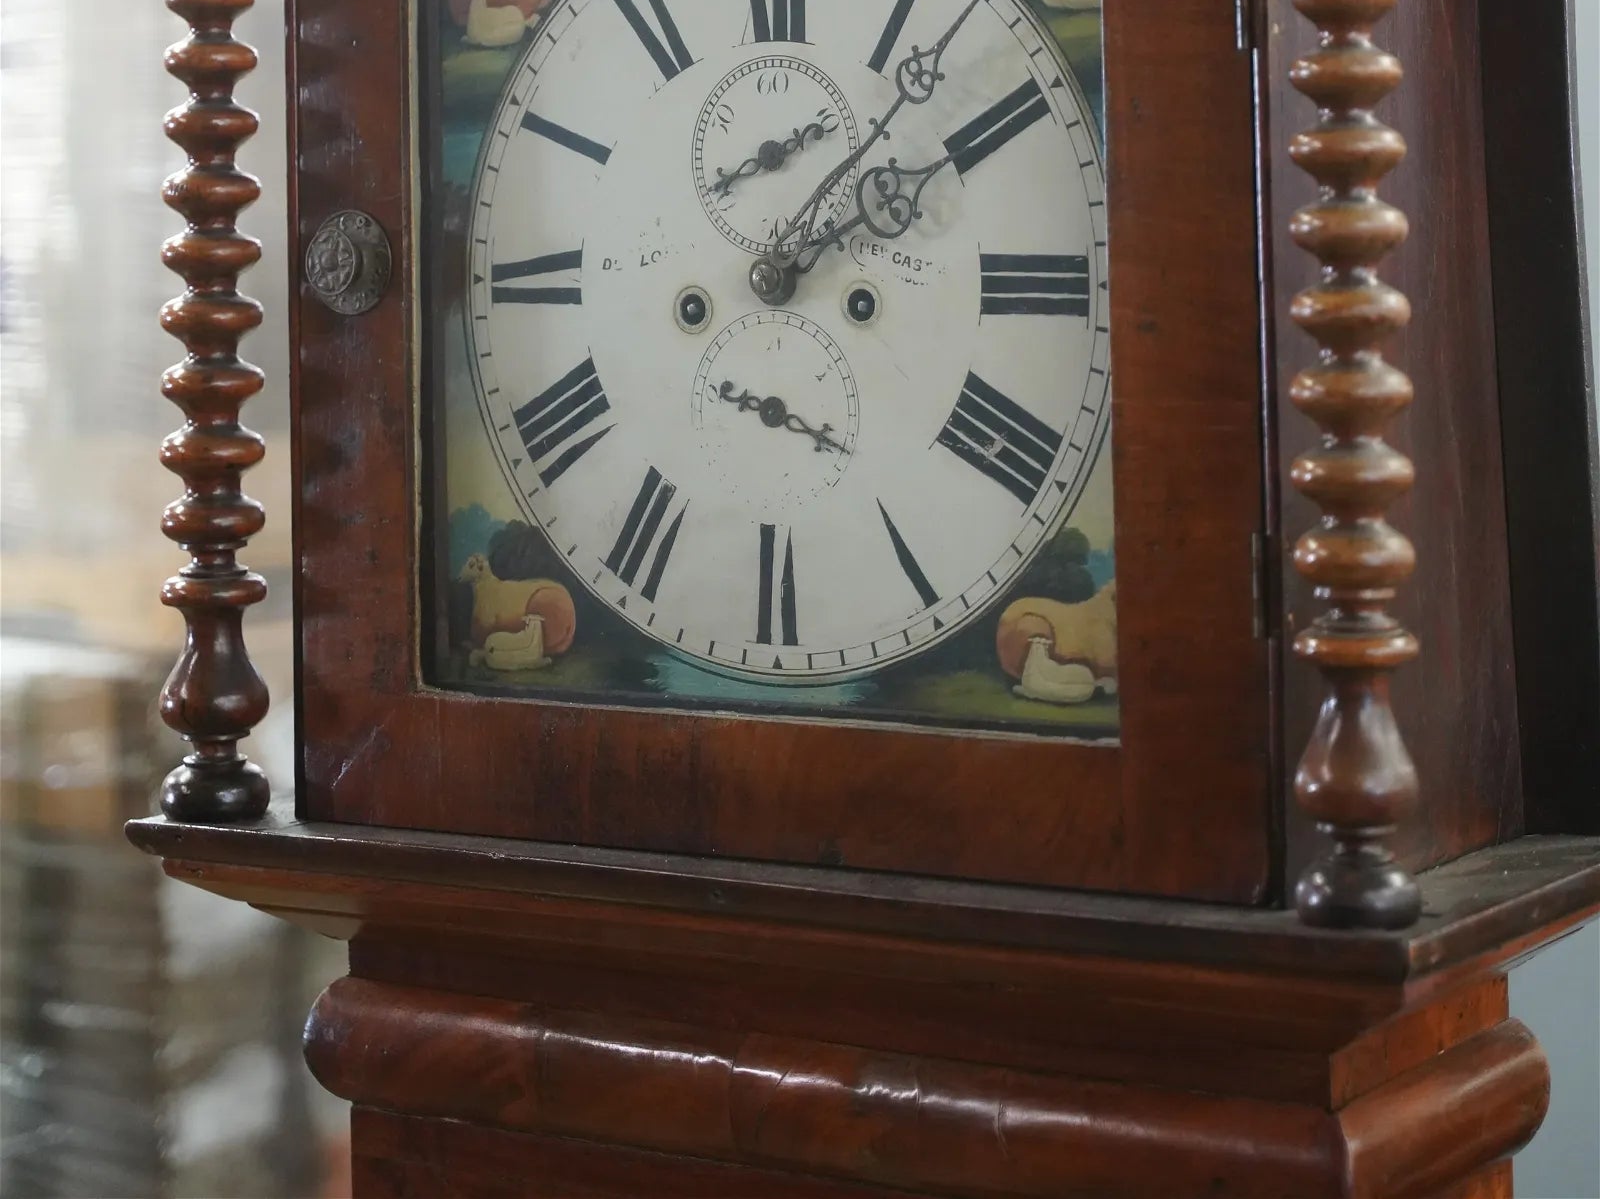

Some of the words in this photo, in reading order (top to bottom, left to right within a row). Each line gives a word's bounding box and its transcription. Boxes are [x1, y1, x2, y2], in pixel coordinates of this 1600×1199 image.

[757, 71, 789, 94] 60
[978, 243, 1090, 326] III
[930, 369, 1069, 518] IIII
